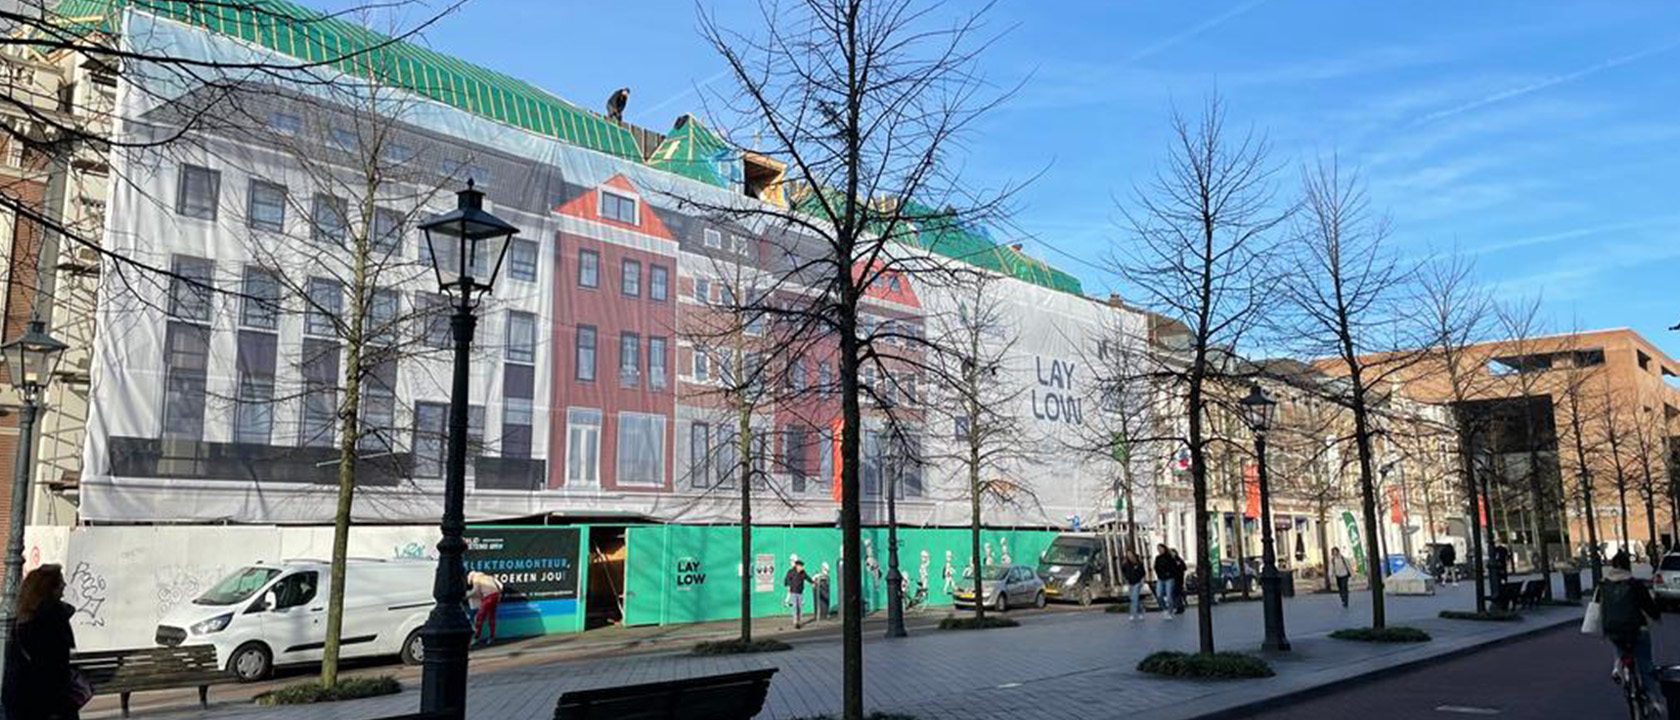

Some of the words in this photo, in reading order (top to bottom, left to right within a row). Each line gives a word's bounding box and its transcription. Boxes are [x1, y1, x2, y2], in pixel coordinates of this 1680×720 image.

[1036, 355, 1075, 390] LAY
[1032, 389, 1082, 425] LOW
[678, 561, 700, 573] LAY
[677, 573, 706, 586] LOW
